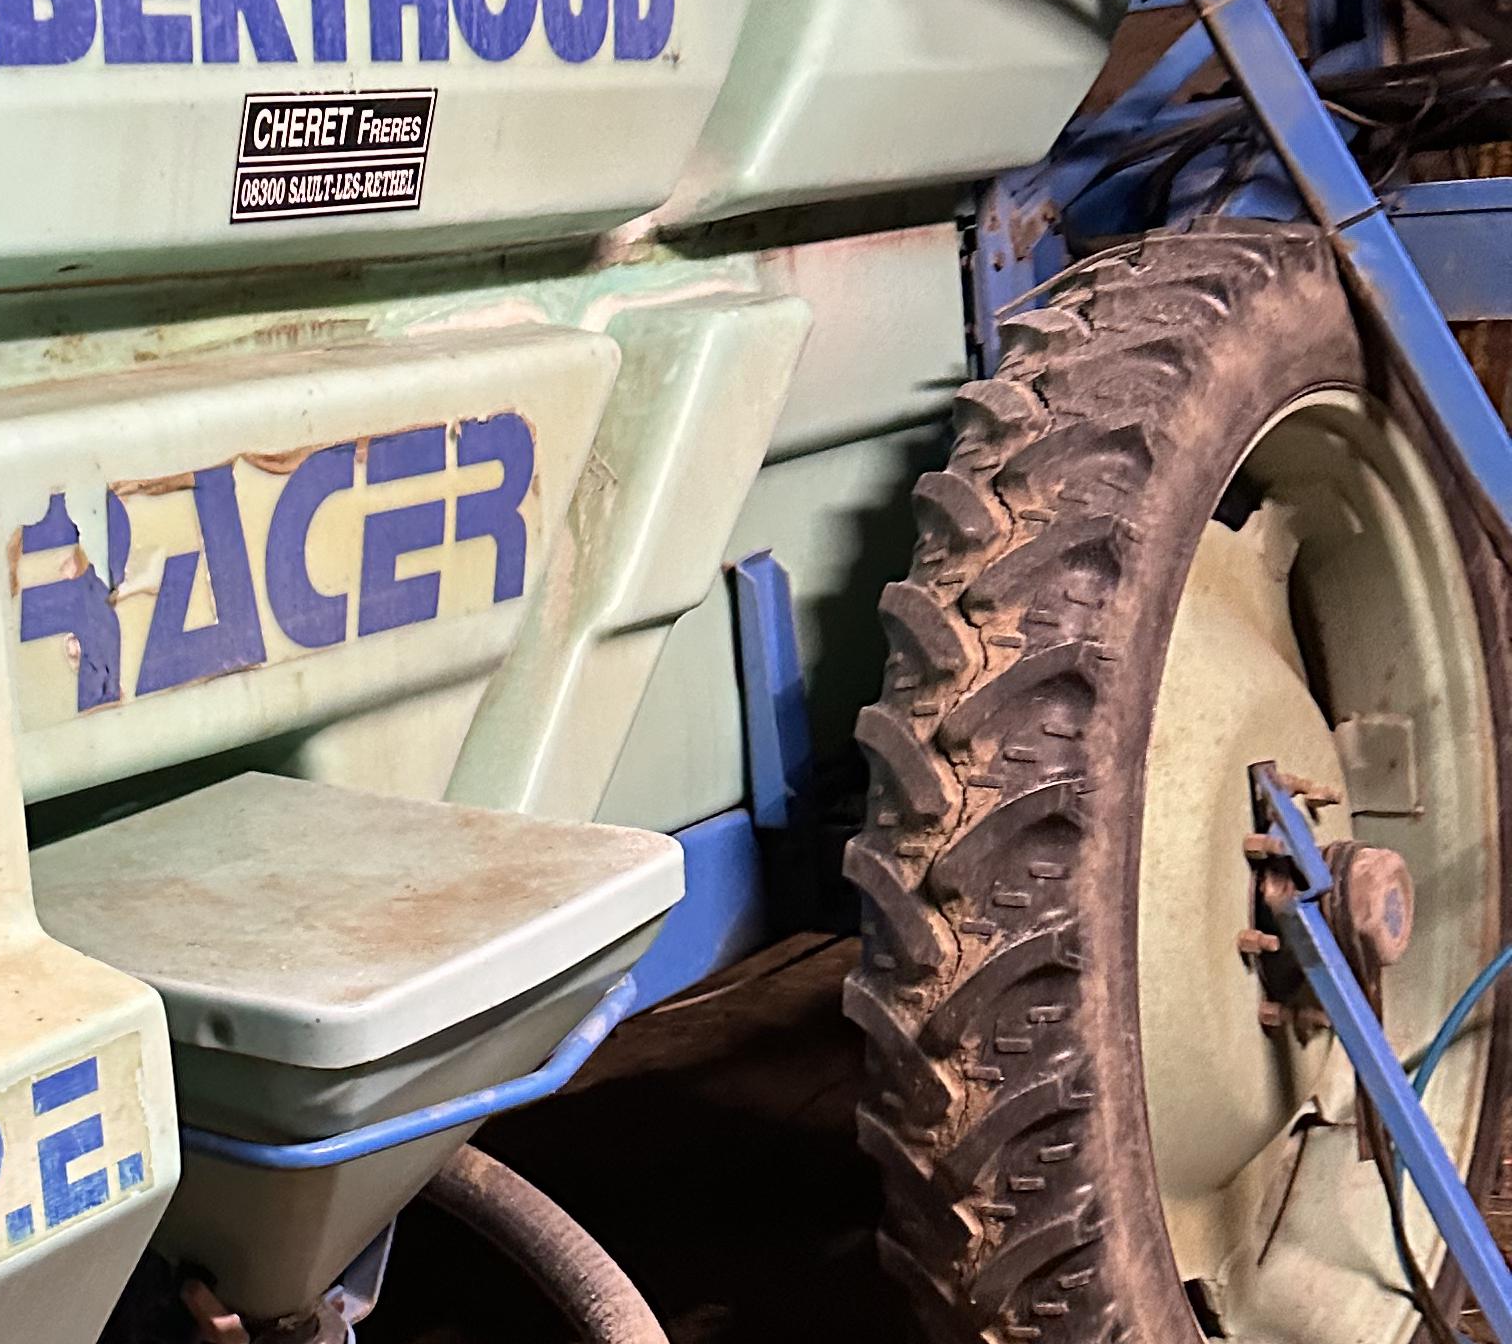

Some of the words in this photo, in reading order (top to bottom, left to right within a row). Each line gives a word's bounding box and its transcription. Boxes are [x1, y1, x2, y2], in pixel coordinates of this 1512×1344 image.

[253, 106, 354, 150] CHERET
[241, 176, 286, 207] 08300
[19, 413, 535, 713] RACER
